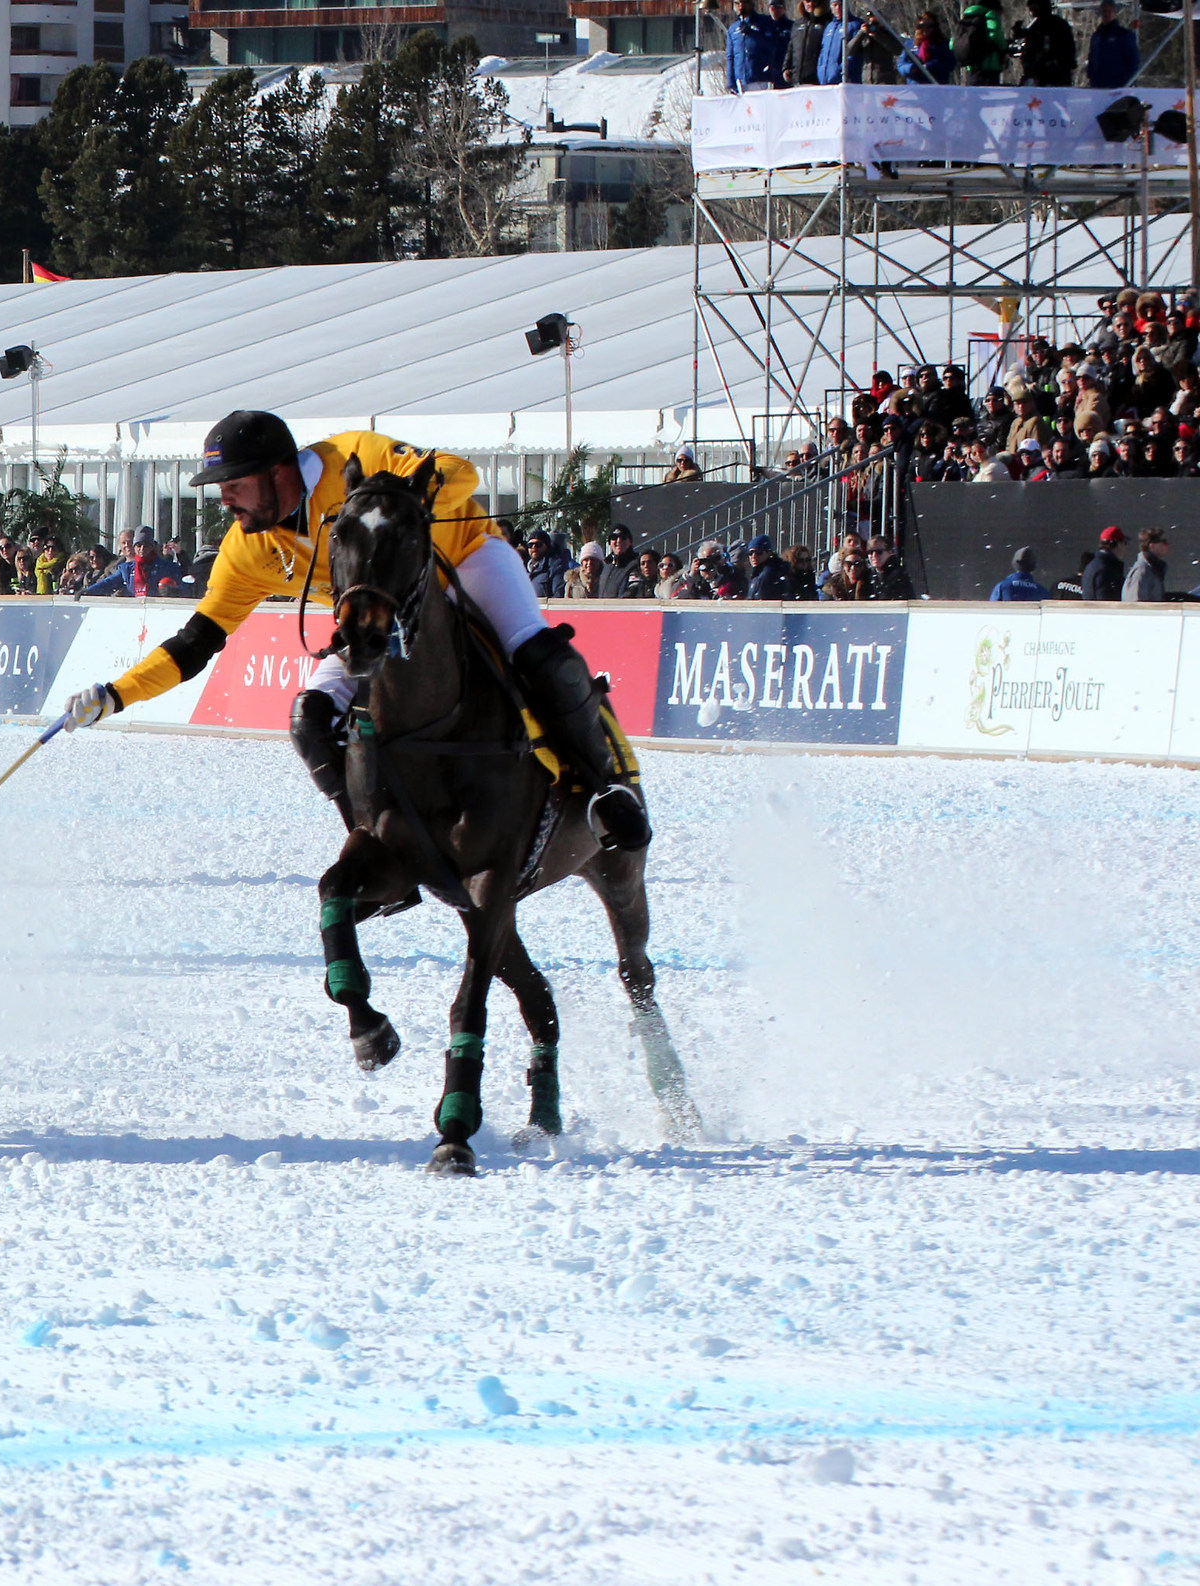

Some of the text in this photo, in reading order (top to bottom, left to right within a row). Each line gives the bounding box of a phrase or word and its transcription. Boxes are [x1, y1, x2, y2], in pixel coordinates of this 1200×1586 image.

[842, 115, 937, 126] SNOWPOLO
[1023, 640, 1076, 656] CHAMPAGNE
[667, 641, 892, 711] MASERATI
